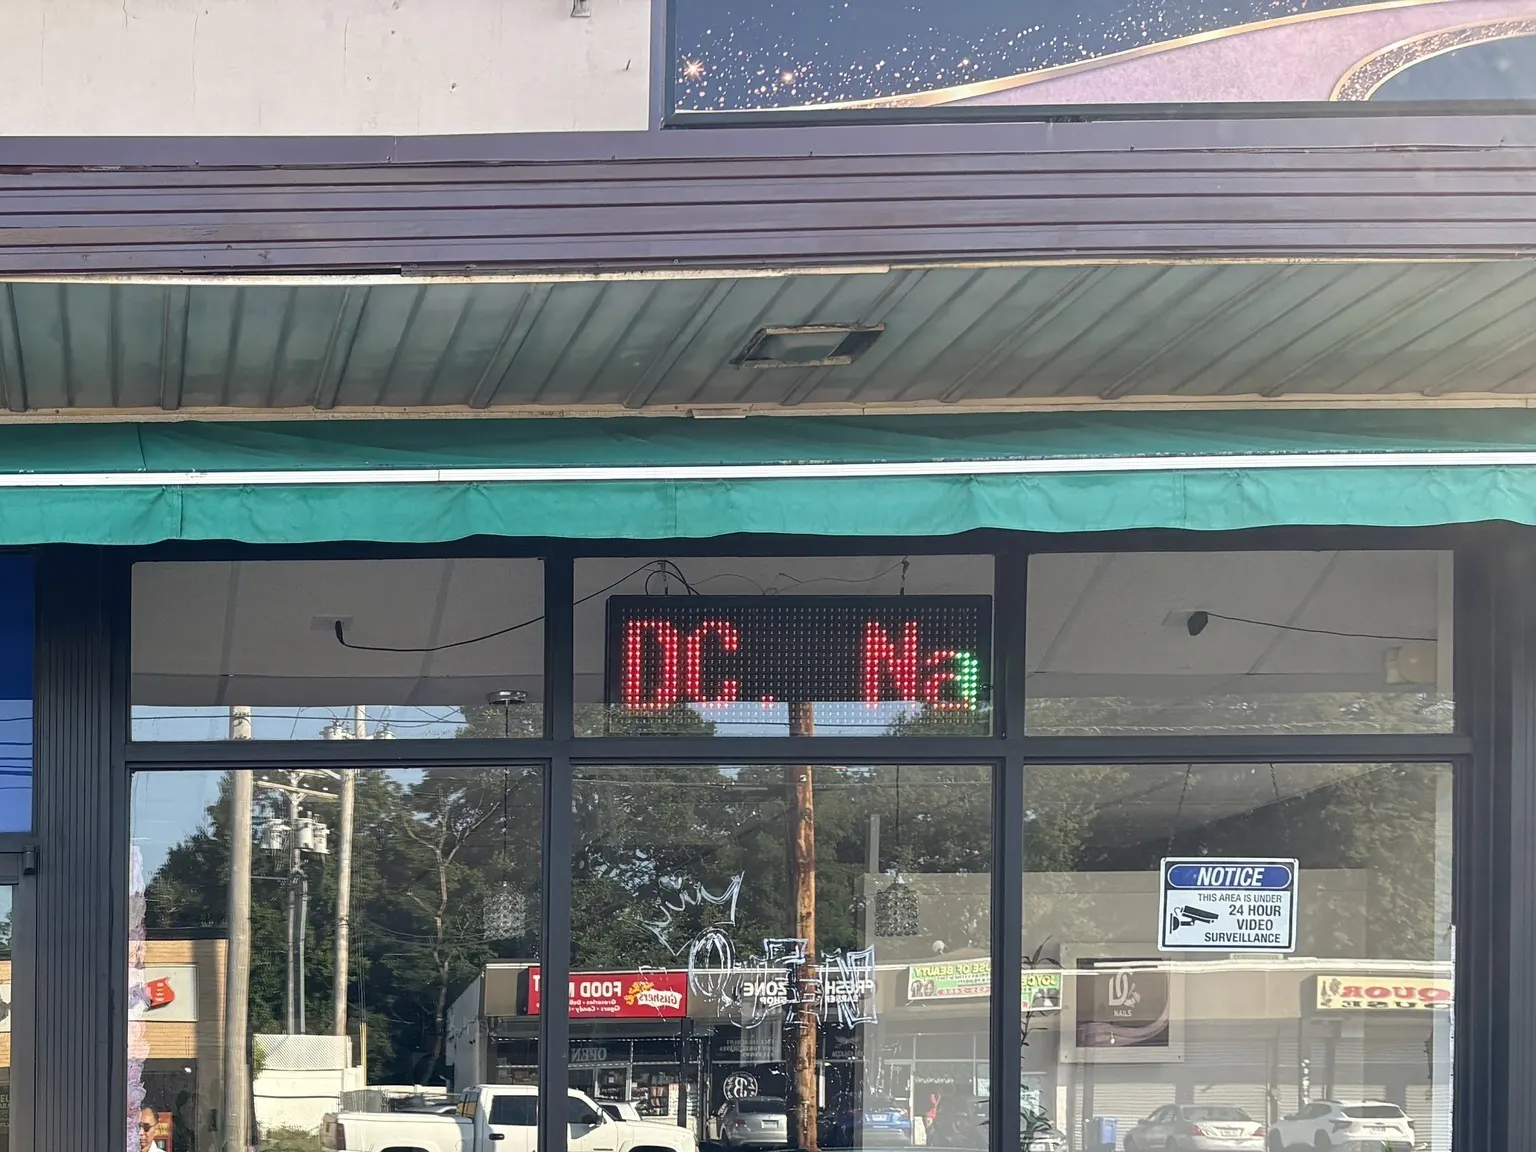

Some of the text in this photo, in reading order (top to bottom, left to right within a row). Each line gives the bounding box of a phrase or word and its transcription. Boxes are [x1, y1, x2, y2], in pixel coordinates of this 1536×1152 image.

[1196, 867, 1265, 887] NOTICE
[1197, 893, 1283, 904] THIS AREA IS UNDER
[1228, 904, 1282, 917] 24 HOUR
[1236, 919, 1275, 931] VIDEO
[1203, 932, 1281, 944] SURVEILLANCE
[1113, 1009, 1133, 1017] NAILS
